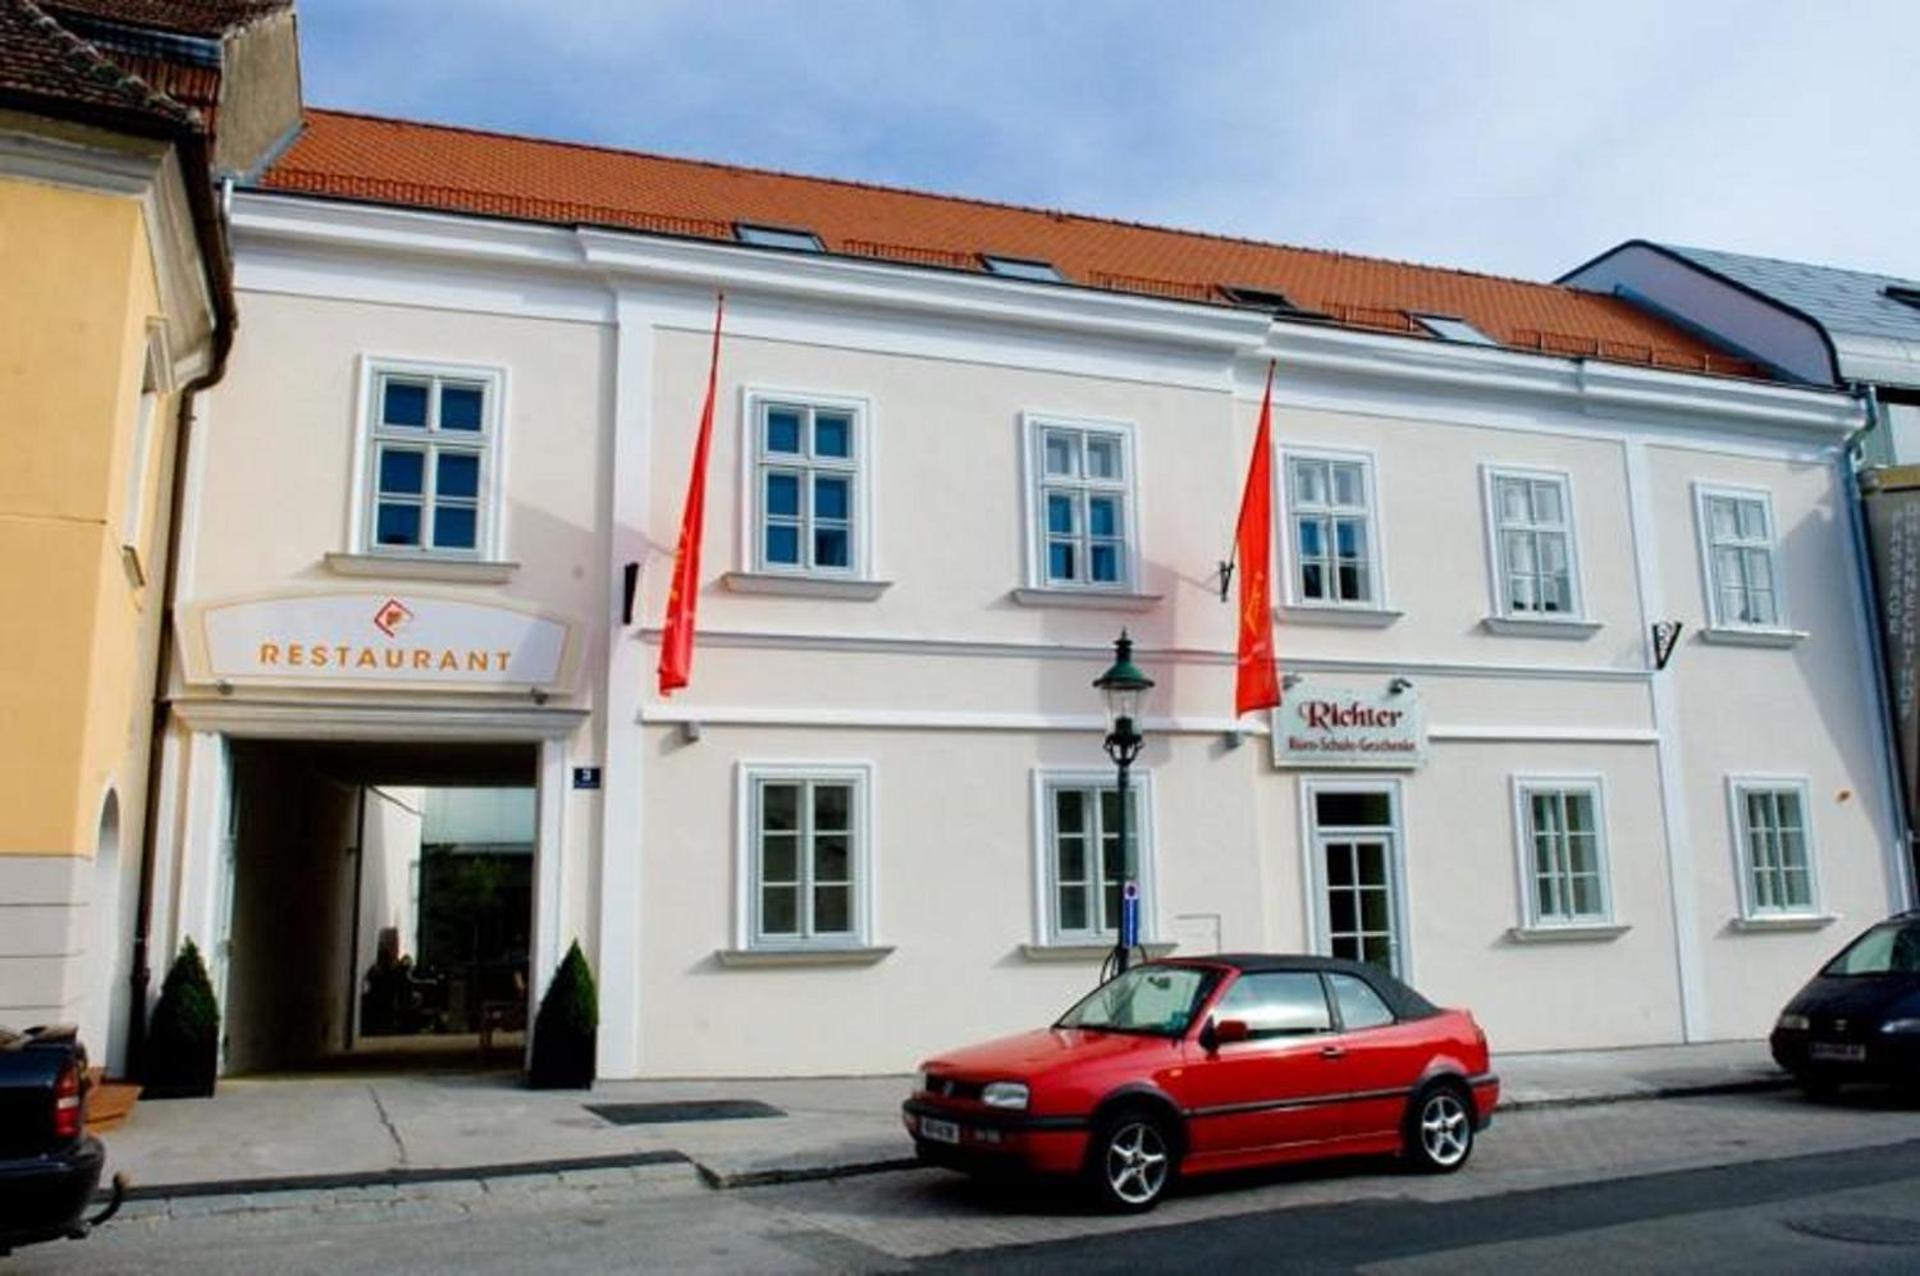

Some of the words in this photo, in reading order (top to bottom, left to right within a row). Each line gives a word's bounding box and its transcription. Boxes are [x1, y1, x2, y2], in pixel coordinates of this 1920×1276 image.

[1889, 511, 1903, 634] PASSAGE
[260, 643, 511, 672] RESTAURANT
[1299, 701, 1403, 733] Richter
